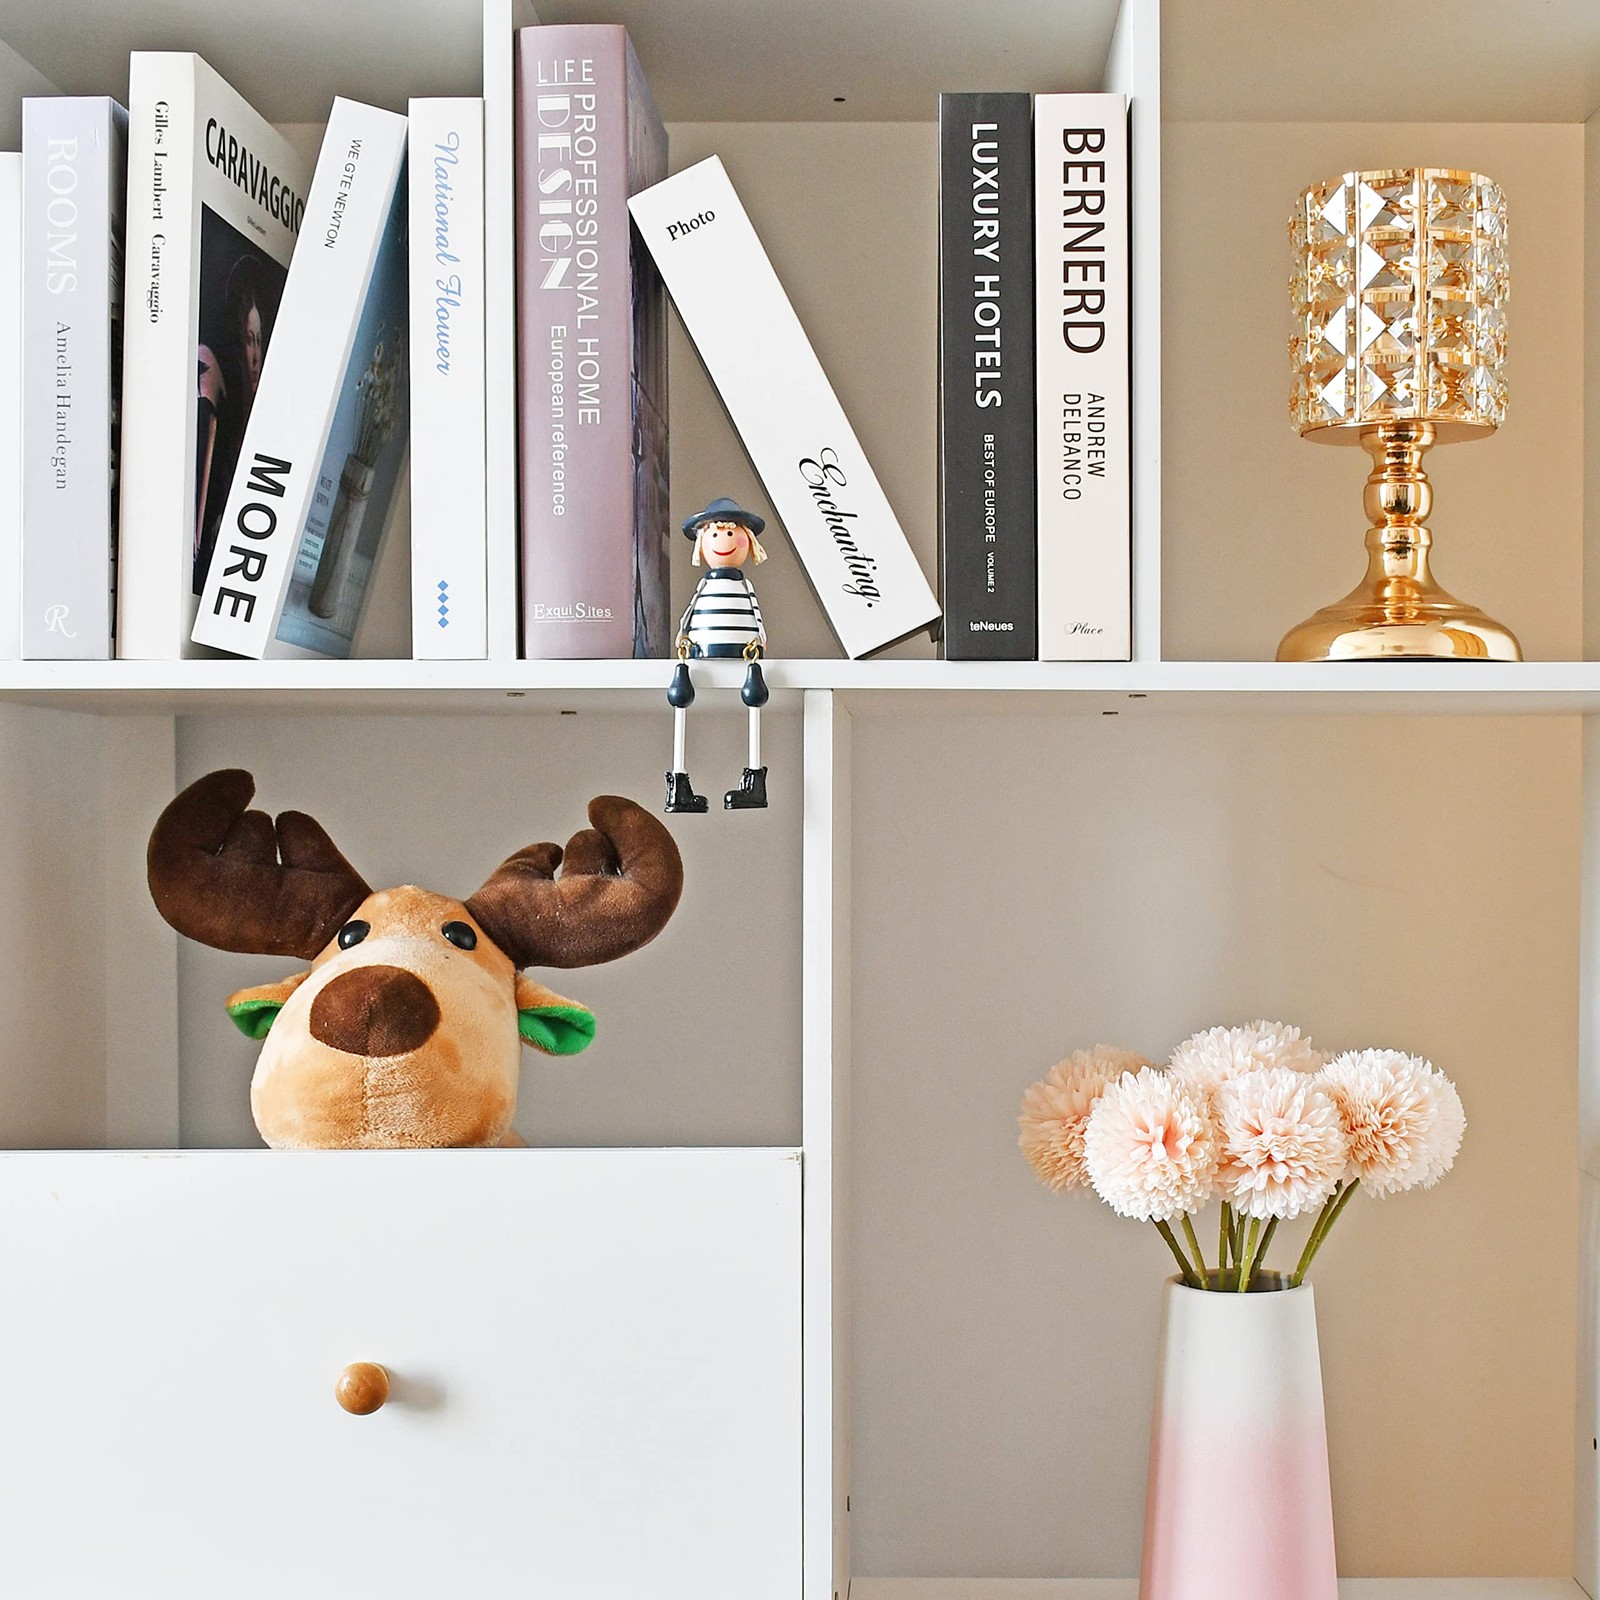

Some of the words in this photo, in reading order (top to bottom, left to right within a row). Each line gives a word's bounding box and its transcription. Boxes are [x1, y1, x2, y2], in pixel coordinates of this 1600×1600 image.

[537, 59, 593, 83] LIFE
[154, 100, 169, 145] Gilles
[348, 139, 363, 160] WE
[47, 138, 78, 295] ROOMS
[152, 152, 168, 220] Lambert
[205, 117, 304, 236] CARAVAGGIO
[340, 162, 356, 190] GTE
[434, 131, 460, 266] National
[537, 93, 573, 290] DESIGN
[574, 94, 599, 329] PROFESSIONAL
[971, 122, 1000, 263] LUXURY
[324, 191, 348, 249] NEWTON
[665, 207, 716, 242] Photo
[1063, 128, 1105, 354] BERNERD
[146, 233, 166, 324] Caravaggio
[56, 321, 72, 388] Amelia
[435, 274, 462, 375] Flower
[973, 275, 1002, 408] HOTELS
[548, 325, 567, 418] European
[577, 338, 600, 425] HOME
[51, 394, 72, 490] Handegan
[552, 423, 569, 516] reference
[984, 434, 995, 467] BEST
[984, 469, 996, 487] OF
[1063, 394, 1081, 500] DELBANCO
[1087, 393, 1105, 477] ANDREW
[213, 453, 292, 623] MORE
[985, 490, 996, 543] EUROPE
[987, 552, 995, 588] VOLUME
[970, 621, 1014, 632] teNeues
[1064, 622, 1104, 636] Place
